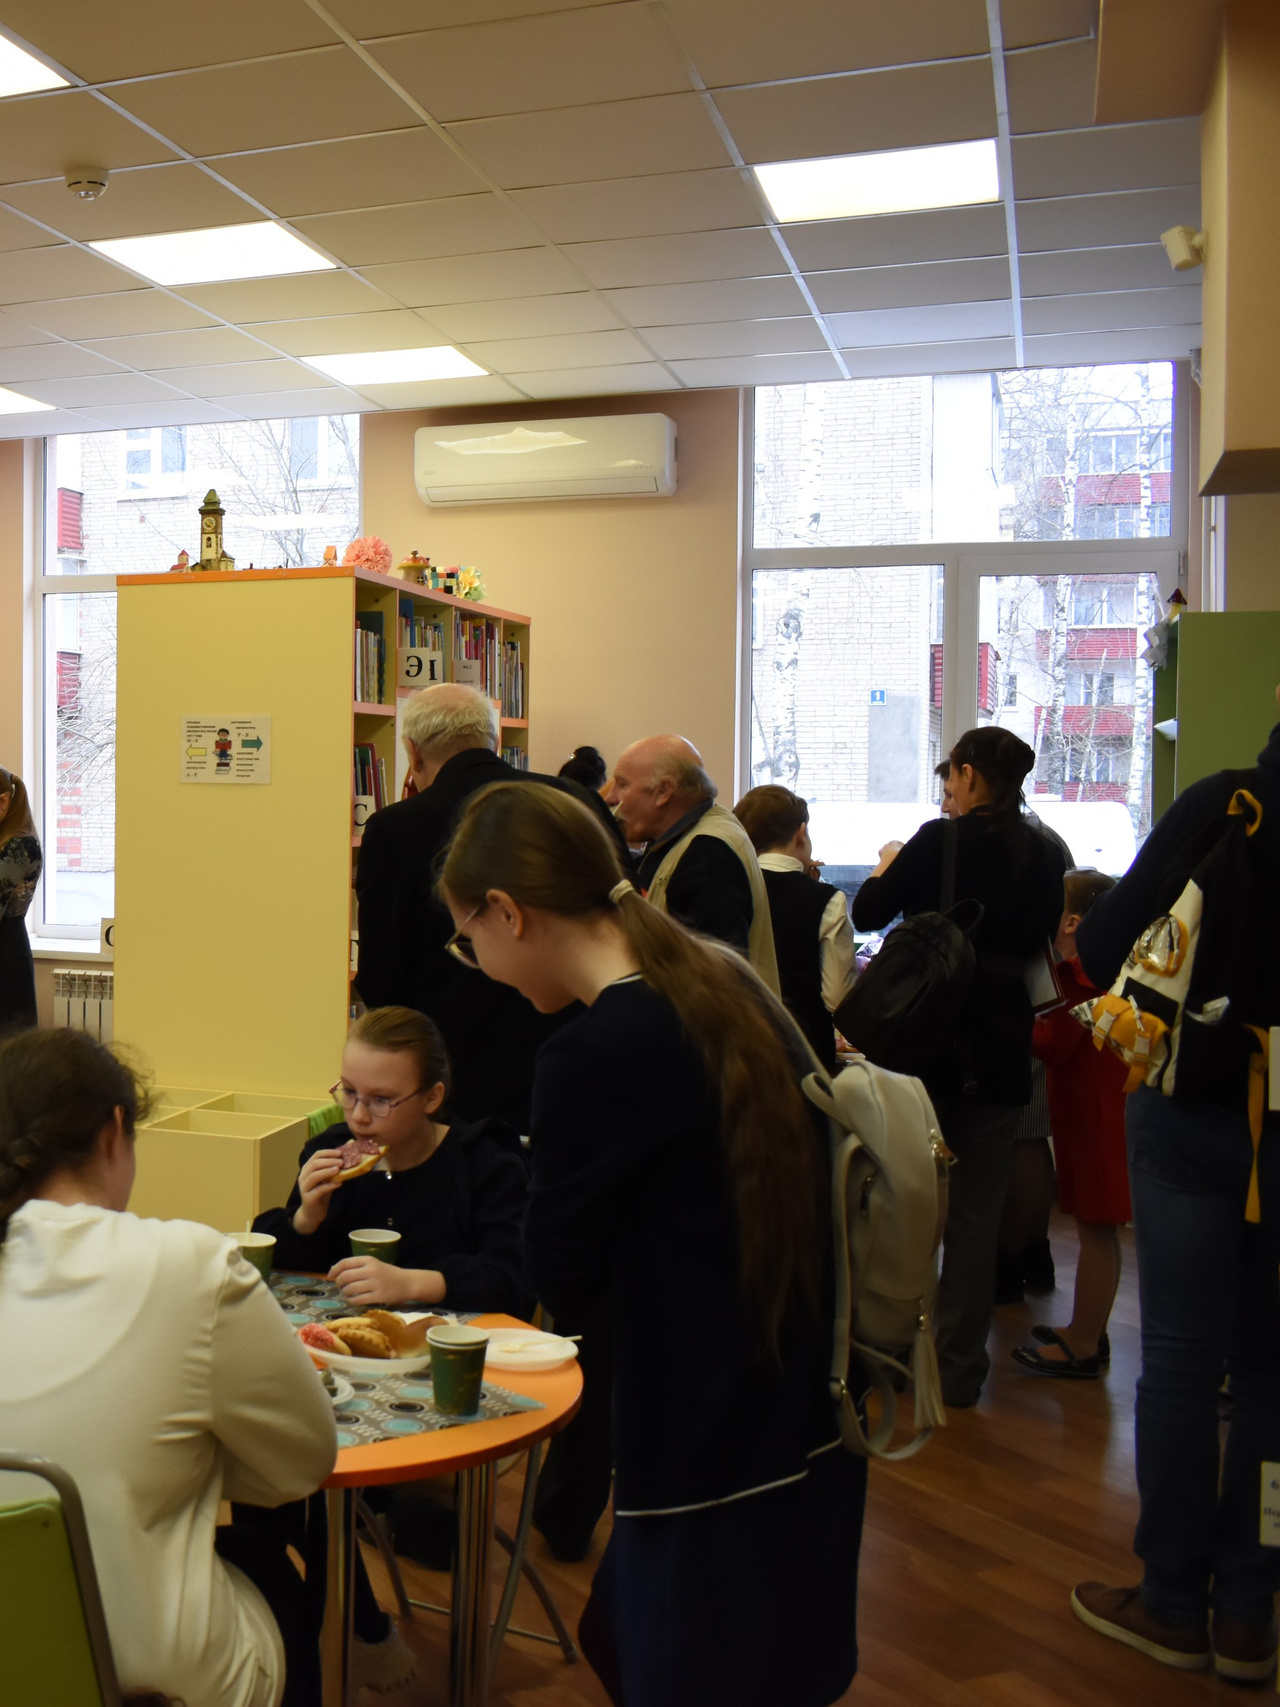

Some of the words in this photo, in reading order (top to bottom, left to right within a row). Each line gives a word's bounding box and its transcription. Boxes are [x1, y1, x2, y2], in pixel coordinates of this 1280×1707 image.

[405, 655, 423, 678] Э
[875, 690, 881, 701] 1
[354, 804, 368, 826] С
